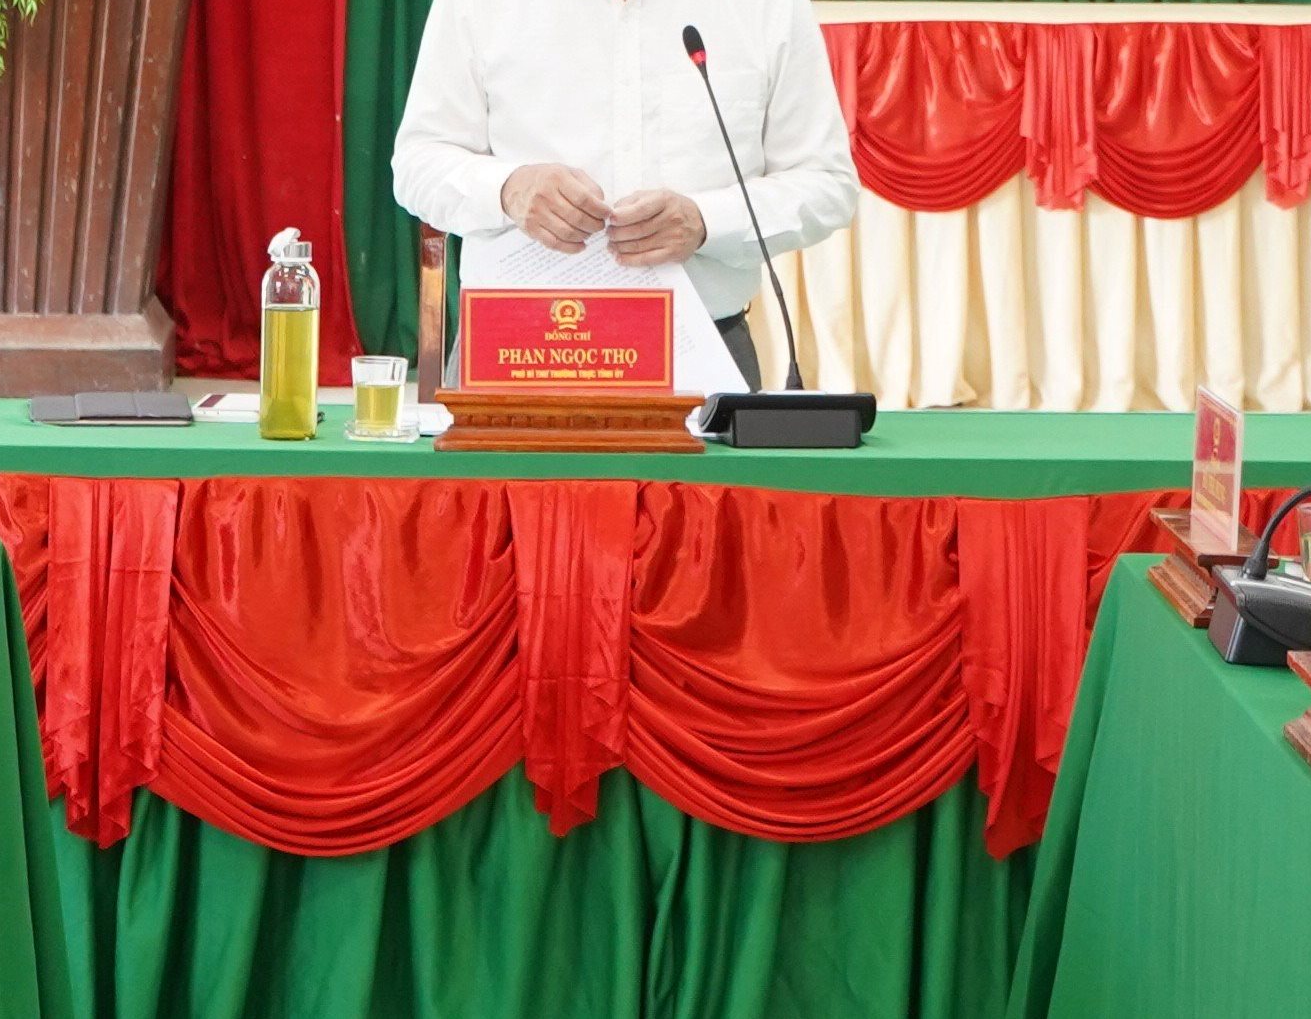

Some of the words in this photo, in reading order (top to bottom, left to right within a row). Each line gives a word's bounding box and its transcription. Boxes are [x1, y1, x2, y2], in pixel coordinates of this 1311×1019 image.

[497, 348, 546, 365] PHAN
[549, 348, 598, 368] NGỌC
[601, 348, 638, 369] THỌ
